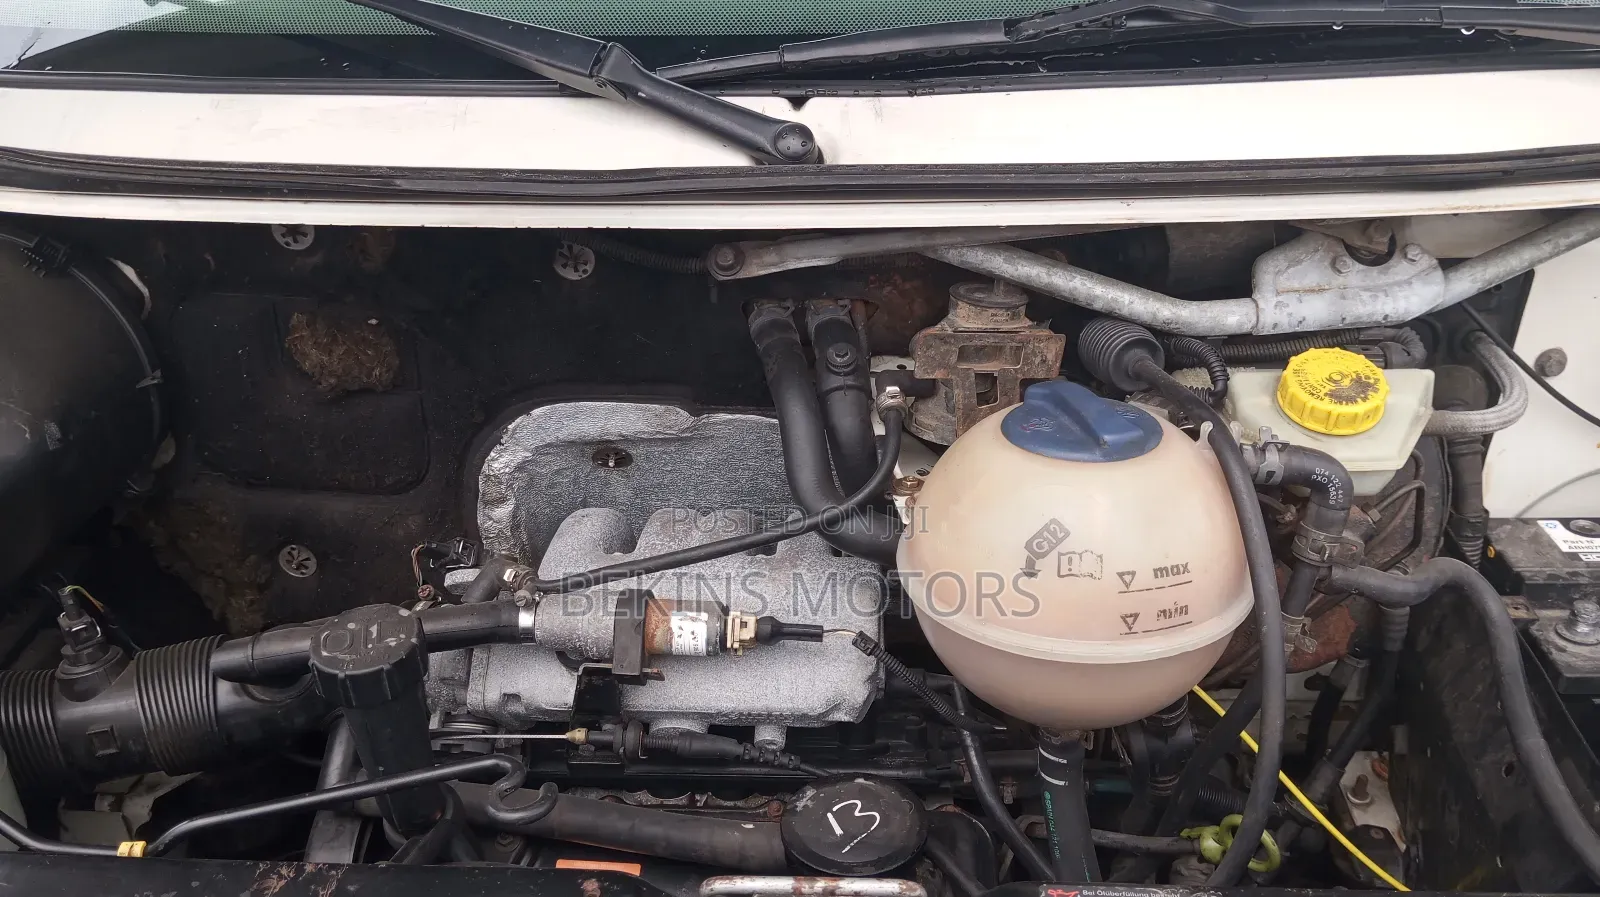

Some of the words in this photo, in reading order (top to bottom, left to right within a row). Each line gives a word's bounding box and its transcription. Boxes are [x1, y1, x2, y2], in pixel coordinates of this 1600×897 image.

[1032, 523, 1065, 554] G12
[1152, 561, 1191, 579] max
[1156, 601, 1190, 621] min
[321, 619, 398, 656] OIL
